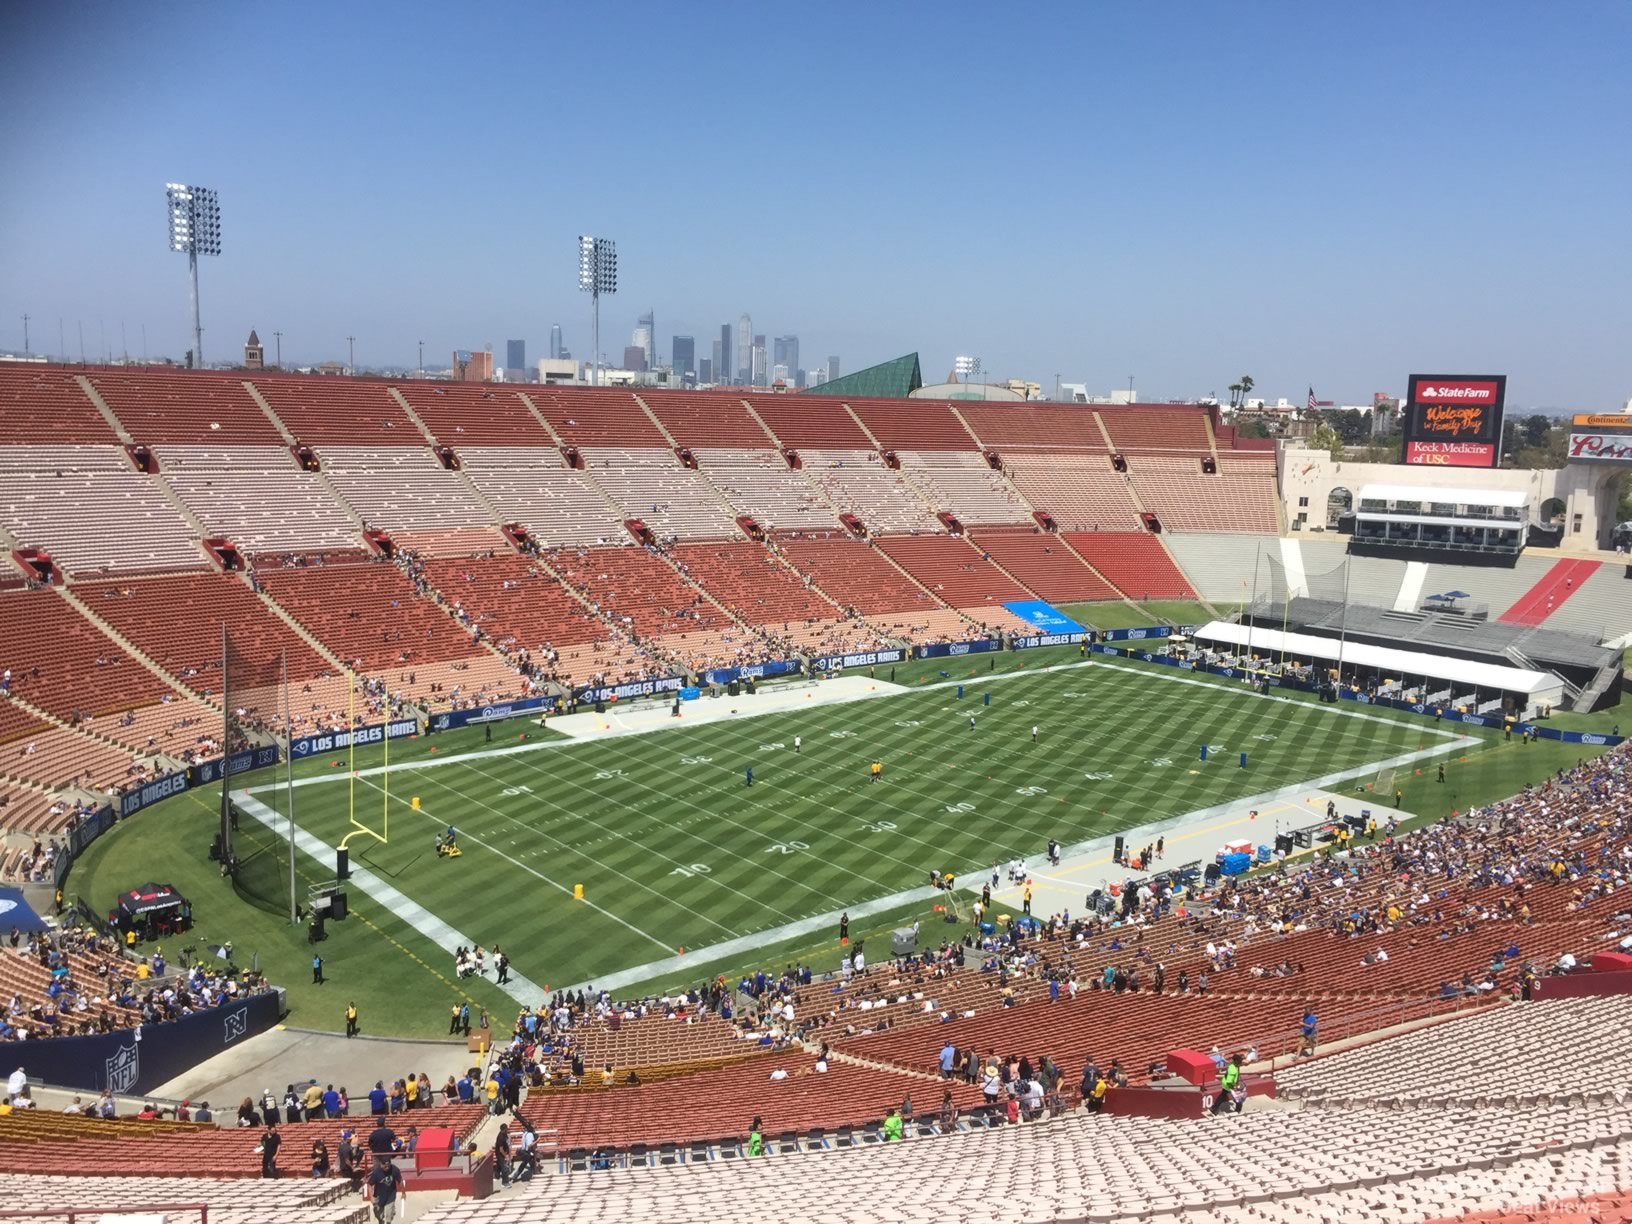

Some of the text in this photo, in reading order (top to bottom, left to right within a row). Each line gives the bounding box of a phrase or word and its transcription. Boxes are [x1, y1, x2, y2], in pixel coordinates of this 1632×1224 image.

[1426, 405, 1482, 420] Welcome
[1432, 419, 1461, 436] Family
[1461, 418, 1482, 434] Day
[1414, 442, 1488, 454] Keck Medicine
[1413, 453, 1450, 464] of USC
[1026, 636, 1040, 647] LOS
[1040, 634, 1069, 646] ANGELES
[843, 653, 876, 667] ANGELES
[878, 651, 900, 662] RAMS
[312, 737, 332, 752] LOS
[335, 727, 382, 749] ANGELES
[124, 773, 186, 815] LOS ANGELES
[1016, 786, 1048, 797] 50
[944, 802, 977, 813] 40
[860, 821, 897, 833] 30
[770, 841, 810, 854] 20
[672, 863, 712, 878] 10
[1534, 980, 1541, 990] 9
[1202, 1095, 1213, 1109] 10
